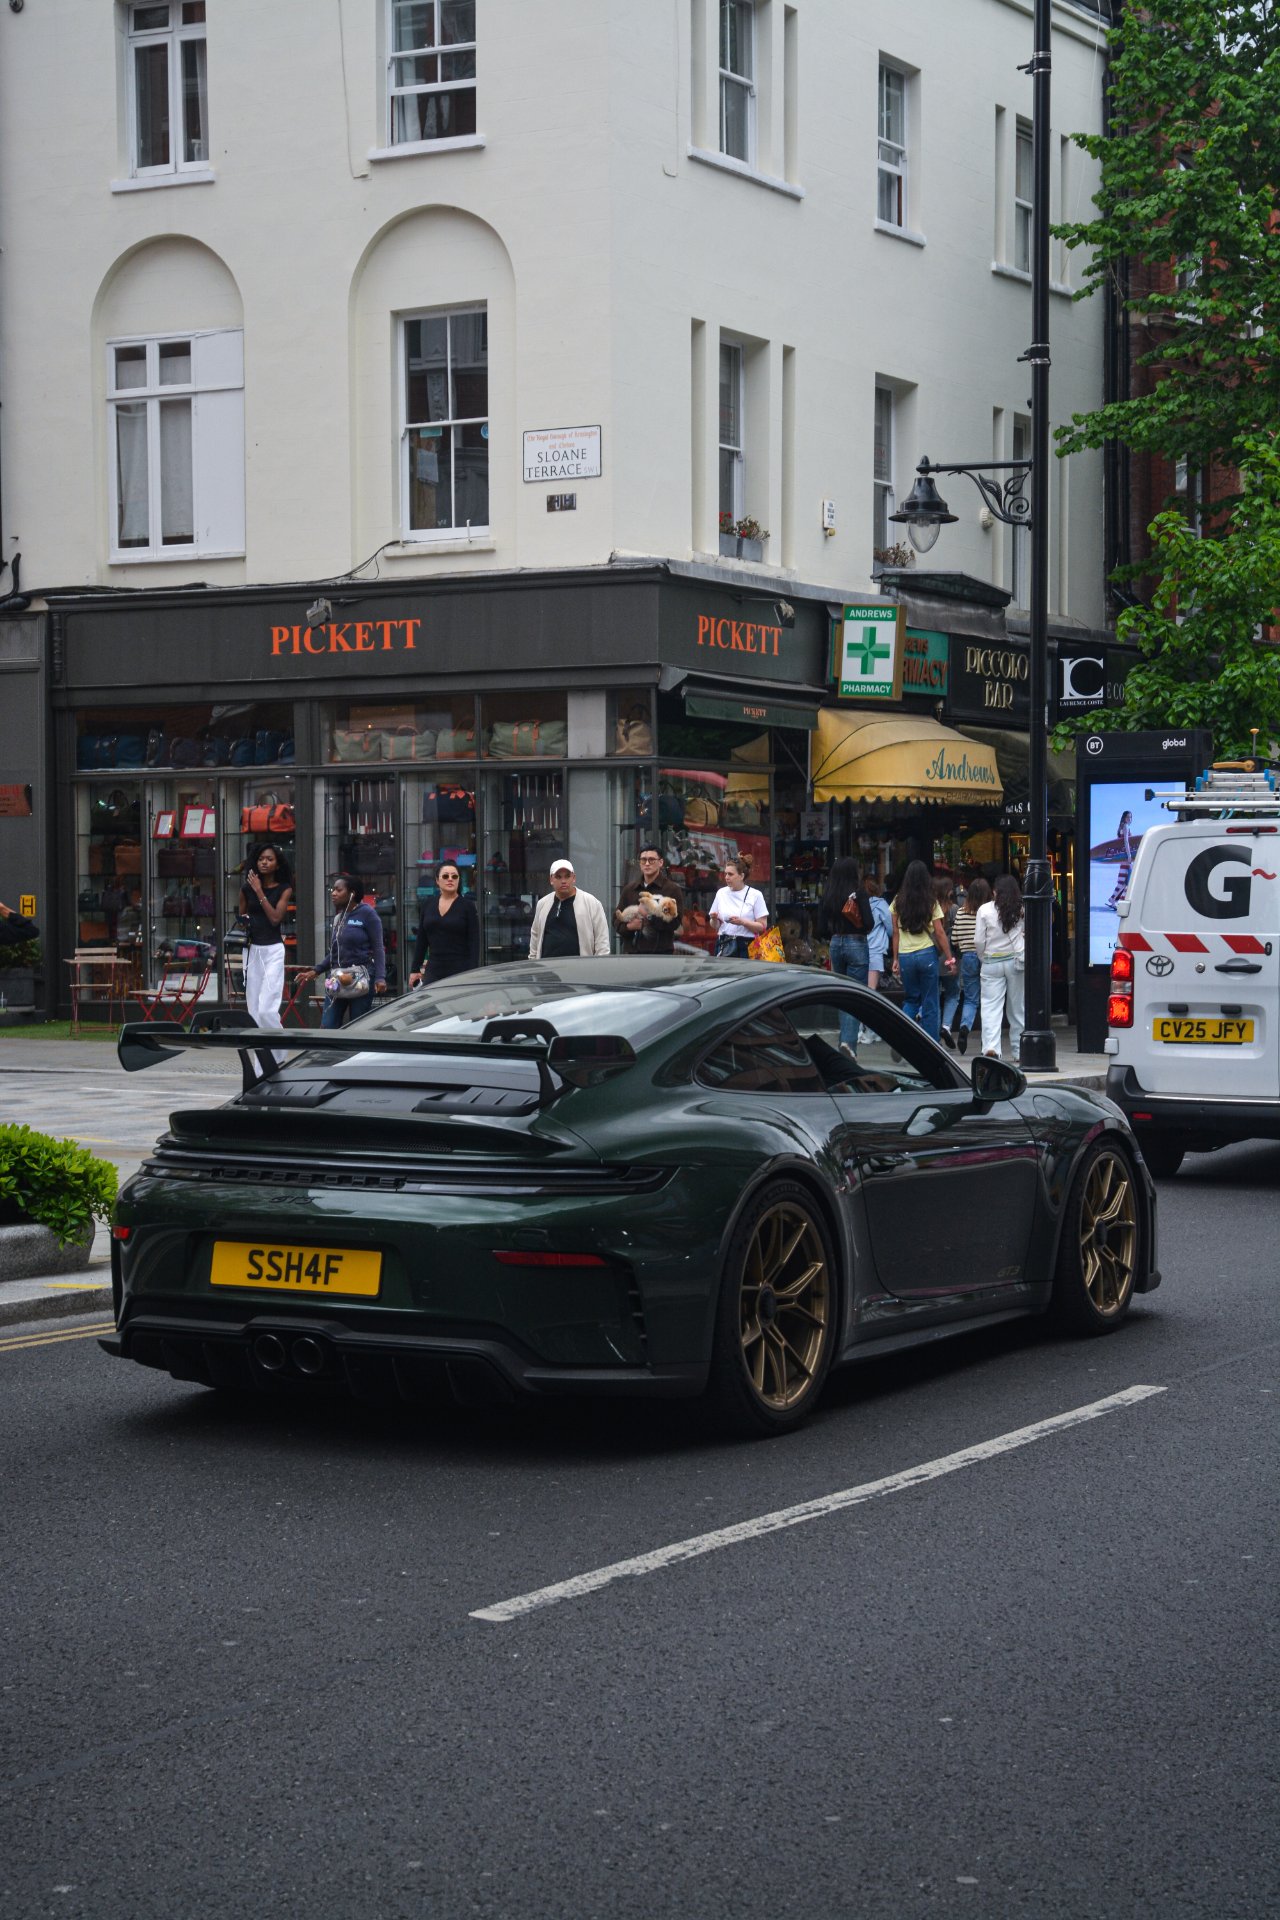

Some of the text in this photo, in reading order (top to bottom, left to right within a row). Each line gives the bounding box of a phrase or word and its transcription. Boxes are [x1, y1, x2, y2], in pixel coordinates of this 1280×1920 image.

[537, 448, 587, 463] SLOANE
[525, 463, 582, 478] TERRACE
[849, 609, 893, 618] ANDREWS
[270, 619, 421, 655] PICKETT
[697, 615, 783, 656] PICKETT
[903, 657, 948, 686] RMACY
[965, 646, 1029, 681] PICCOLO
[843, 684, 891, 694] PHARMACY
[984, 680, 1014, 711] BAR
[1089, 741, 1100, 749] BT
[1162, 738, 1186, 750] global
[926, 747, 995, 784] Andrews
[22, 897, 34, 915] H
[1160, 1021, 1247, 1039] CV25 JFY
[223, 1168, 394, 1187] PORSCHE
[247, 1249, 344, 1285] SSH4F
